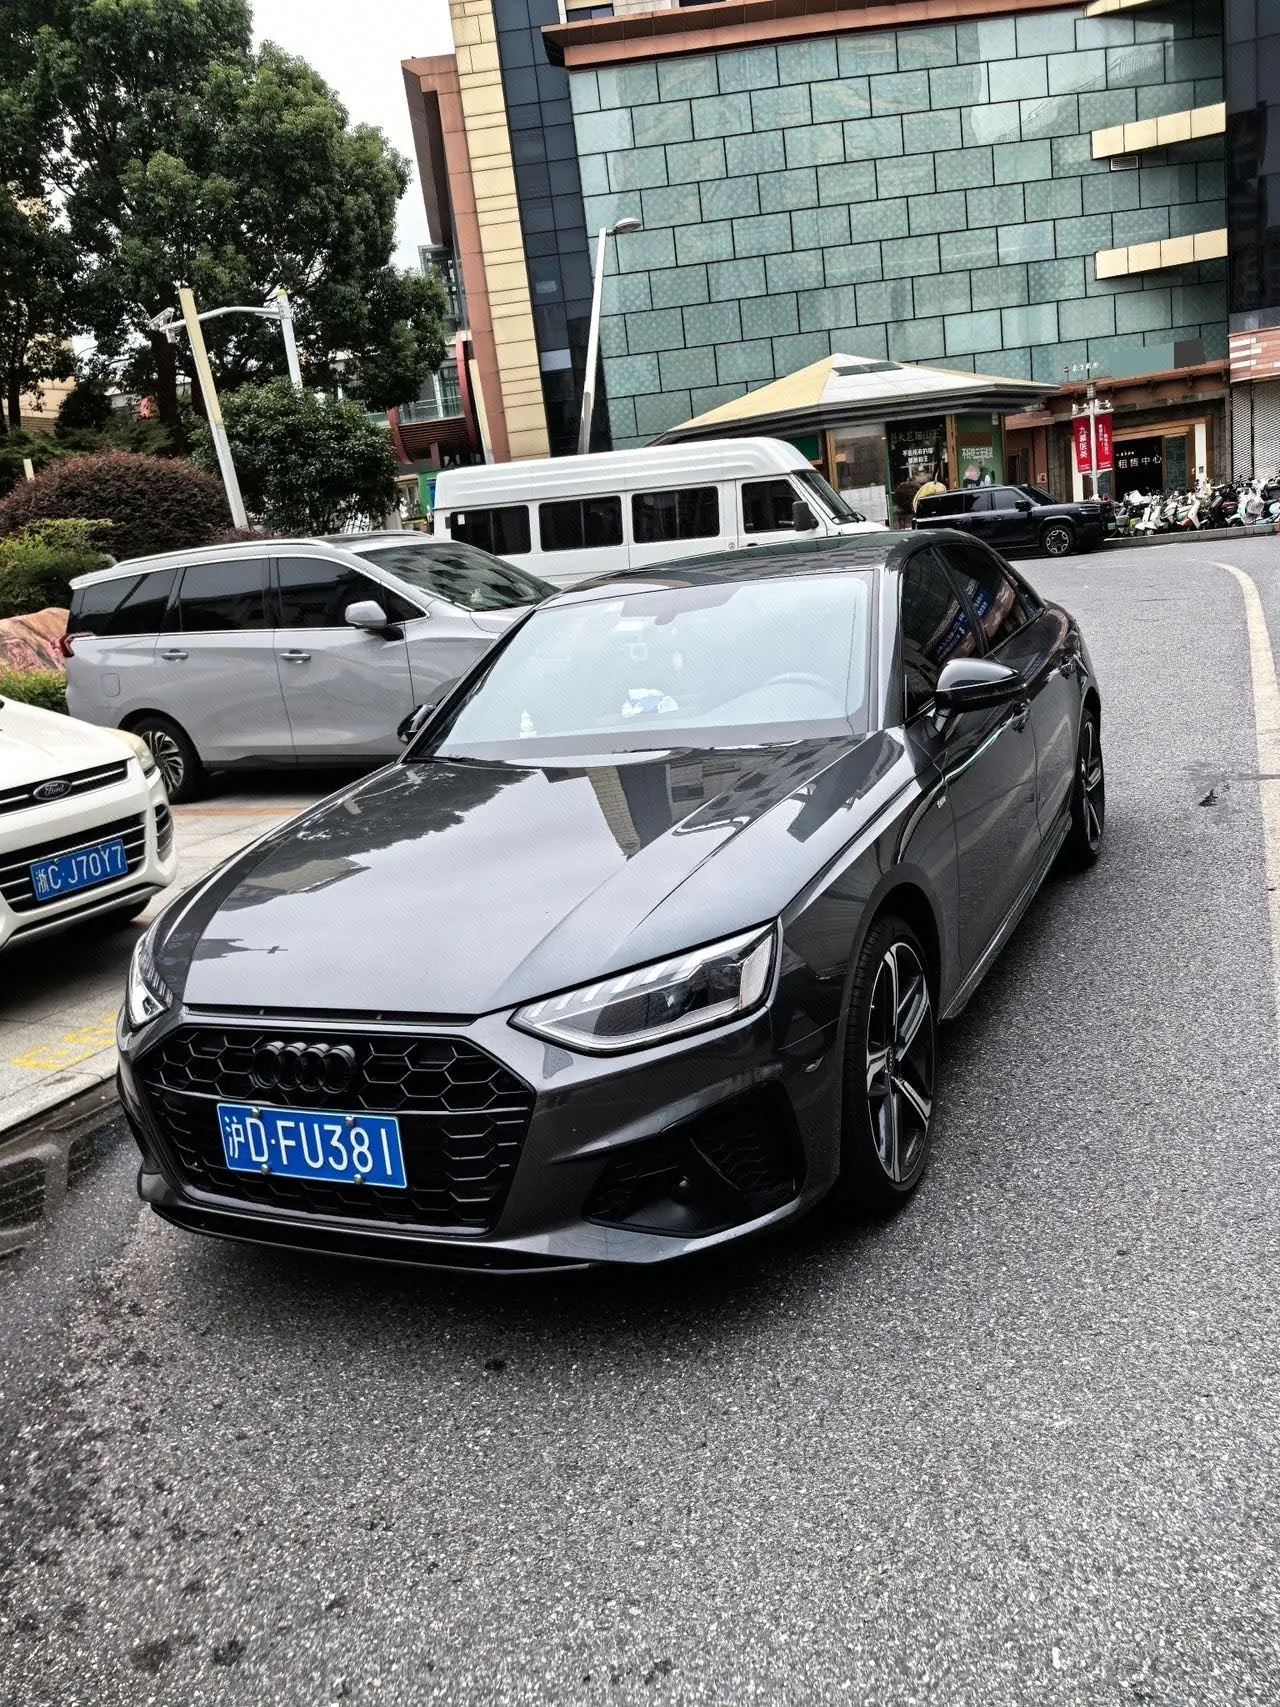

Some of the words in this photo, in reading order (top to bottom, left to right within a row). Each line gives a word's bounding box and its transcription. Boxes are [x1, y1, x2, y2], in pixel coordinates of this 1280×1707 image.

[1117, 454, 1163, 469] 租售中心
[44, 783, 66, 796] Ford
